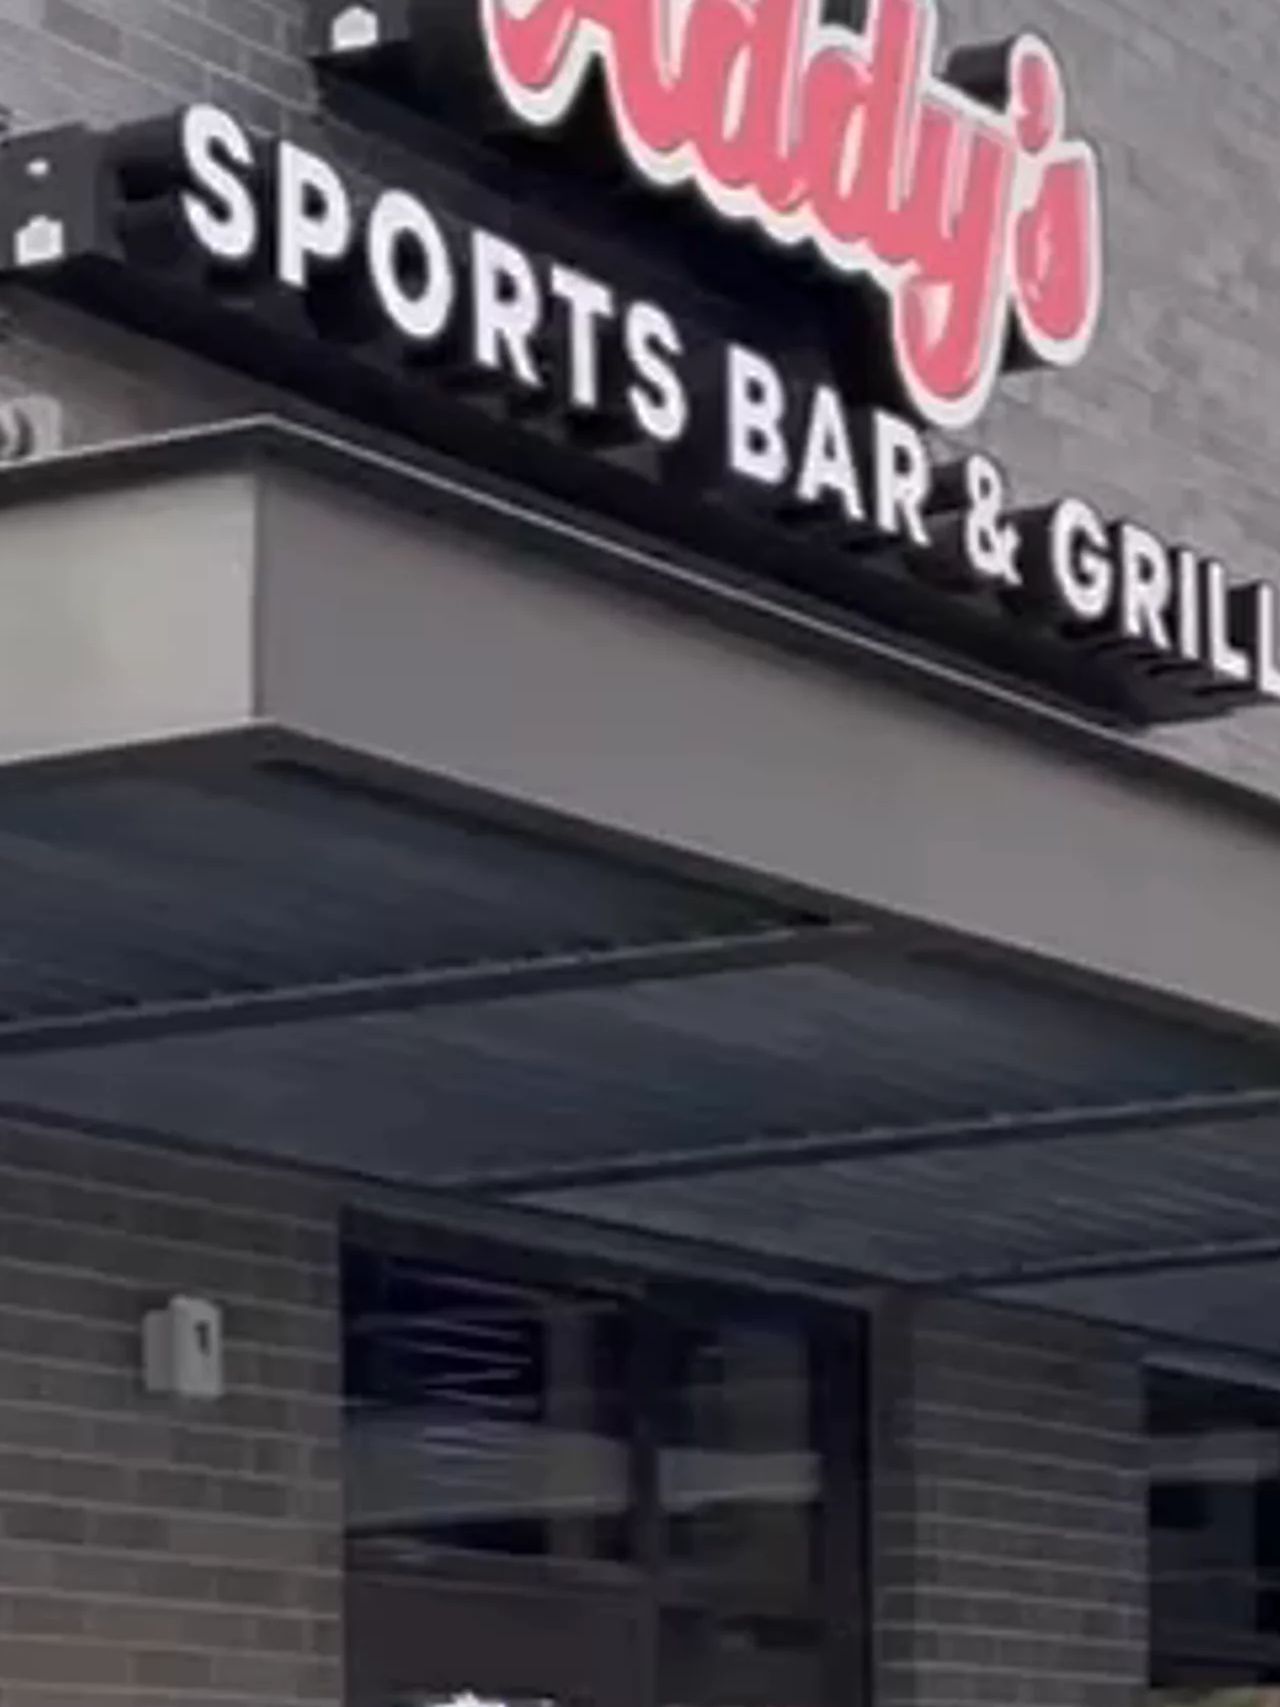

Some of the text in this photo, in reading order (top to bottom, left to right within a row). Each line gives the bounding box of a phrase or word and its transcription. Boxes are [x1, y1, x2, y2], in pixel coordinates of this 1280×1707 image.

[180, 104, 688, 441] SPORTS
[727, 347, 928, 547] BAR
[962, 454, 1021, 589] &
